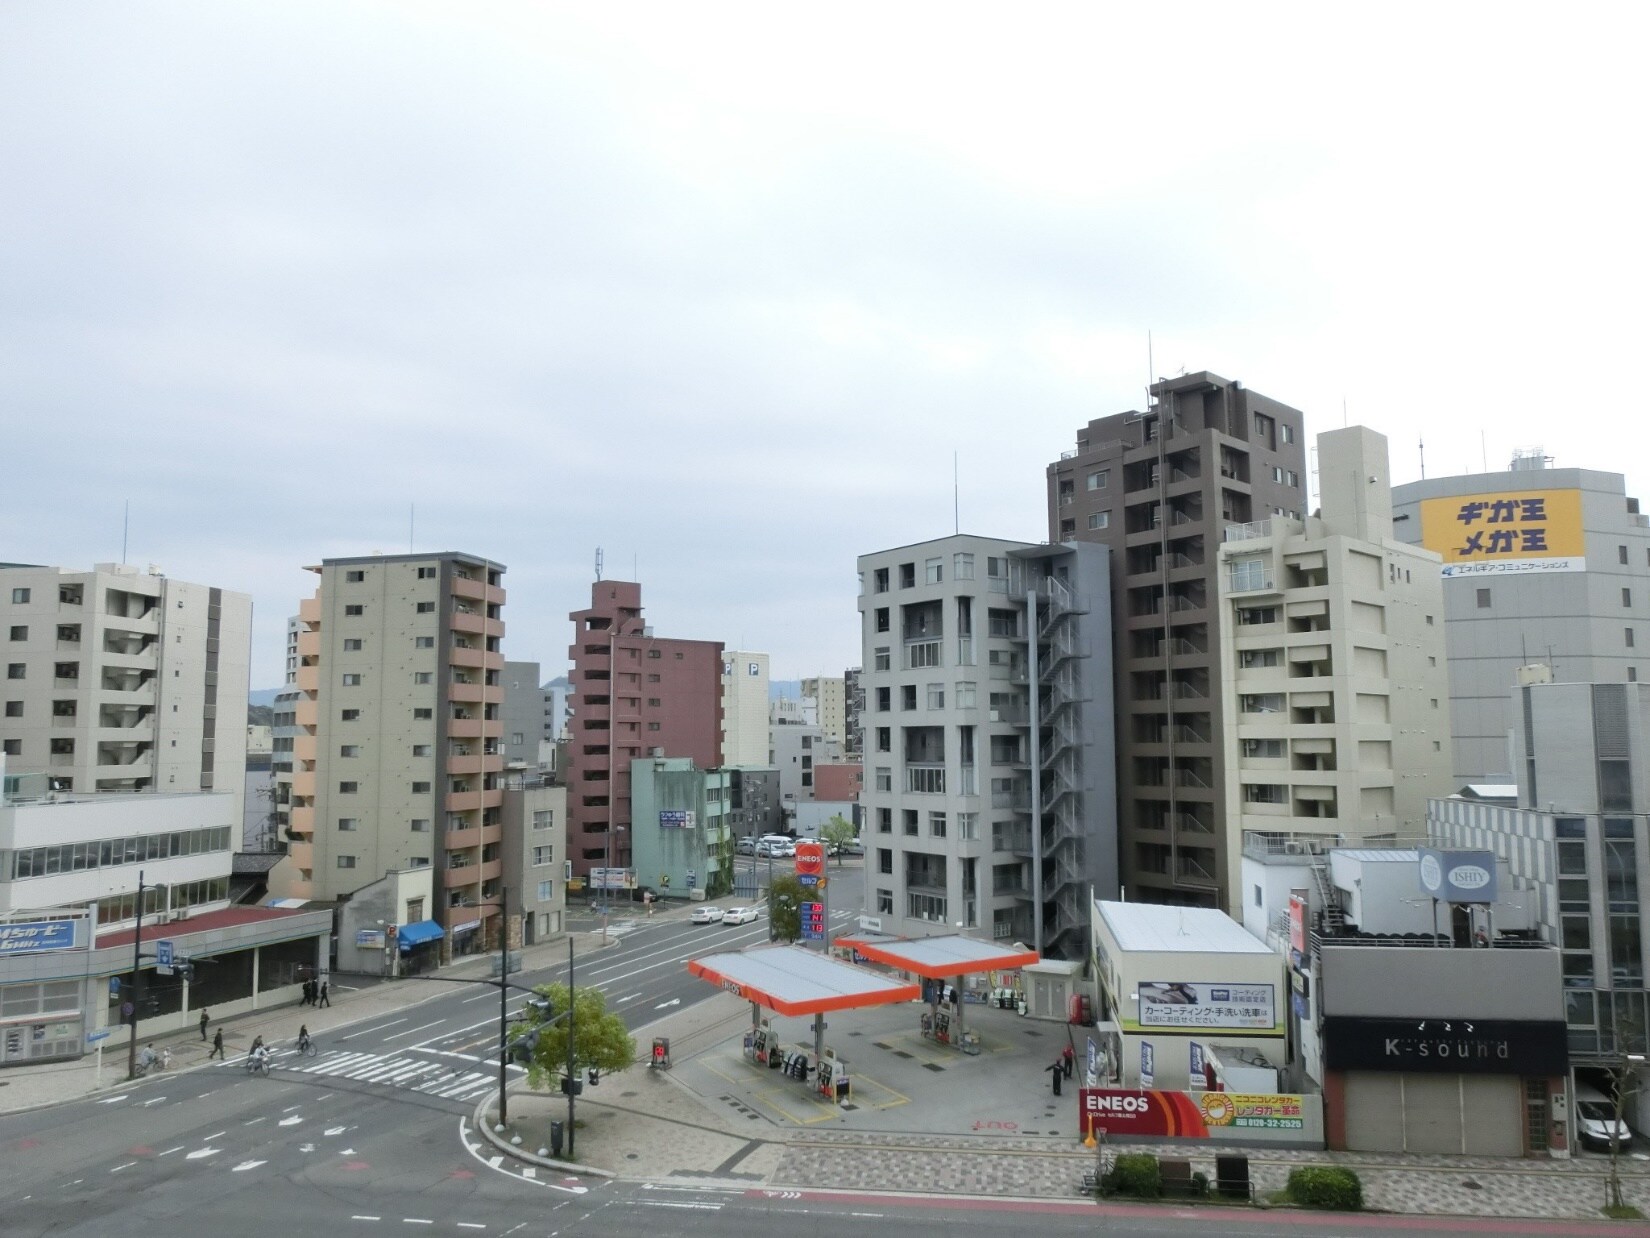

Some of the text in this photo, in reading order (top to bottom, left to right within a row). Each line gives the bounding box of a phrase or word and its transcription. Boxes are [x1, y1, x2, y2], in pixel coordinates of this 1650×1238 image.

[1457, 499, 1547, 525] ギガ王
[1459, 529, 1548, 555] メガ王
[1458, 561, 1569, 574] エネルギア・コミュニケーションズ
[725, 664, 731, 675] P
[751, 664, 758, 675] P
[1385, 1038, 1508, 1058] K-sound
[1087, 1095, 1148, 1112] ENEOS
[1236, 1105, 1300, 1116] レンタカー革命
[1248, 1119, 1301, 1128] 0120-32-2525
